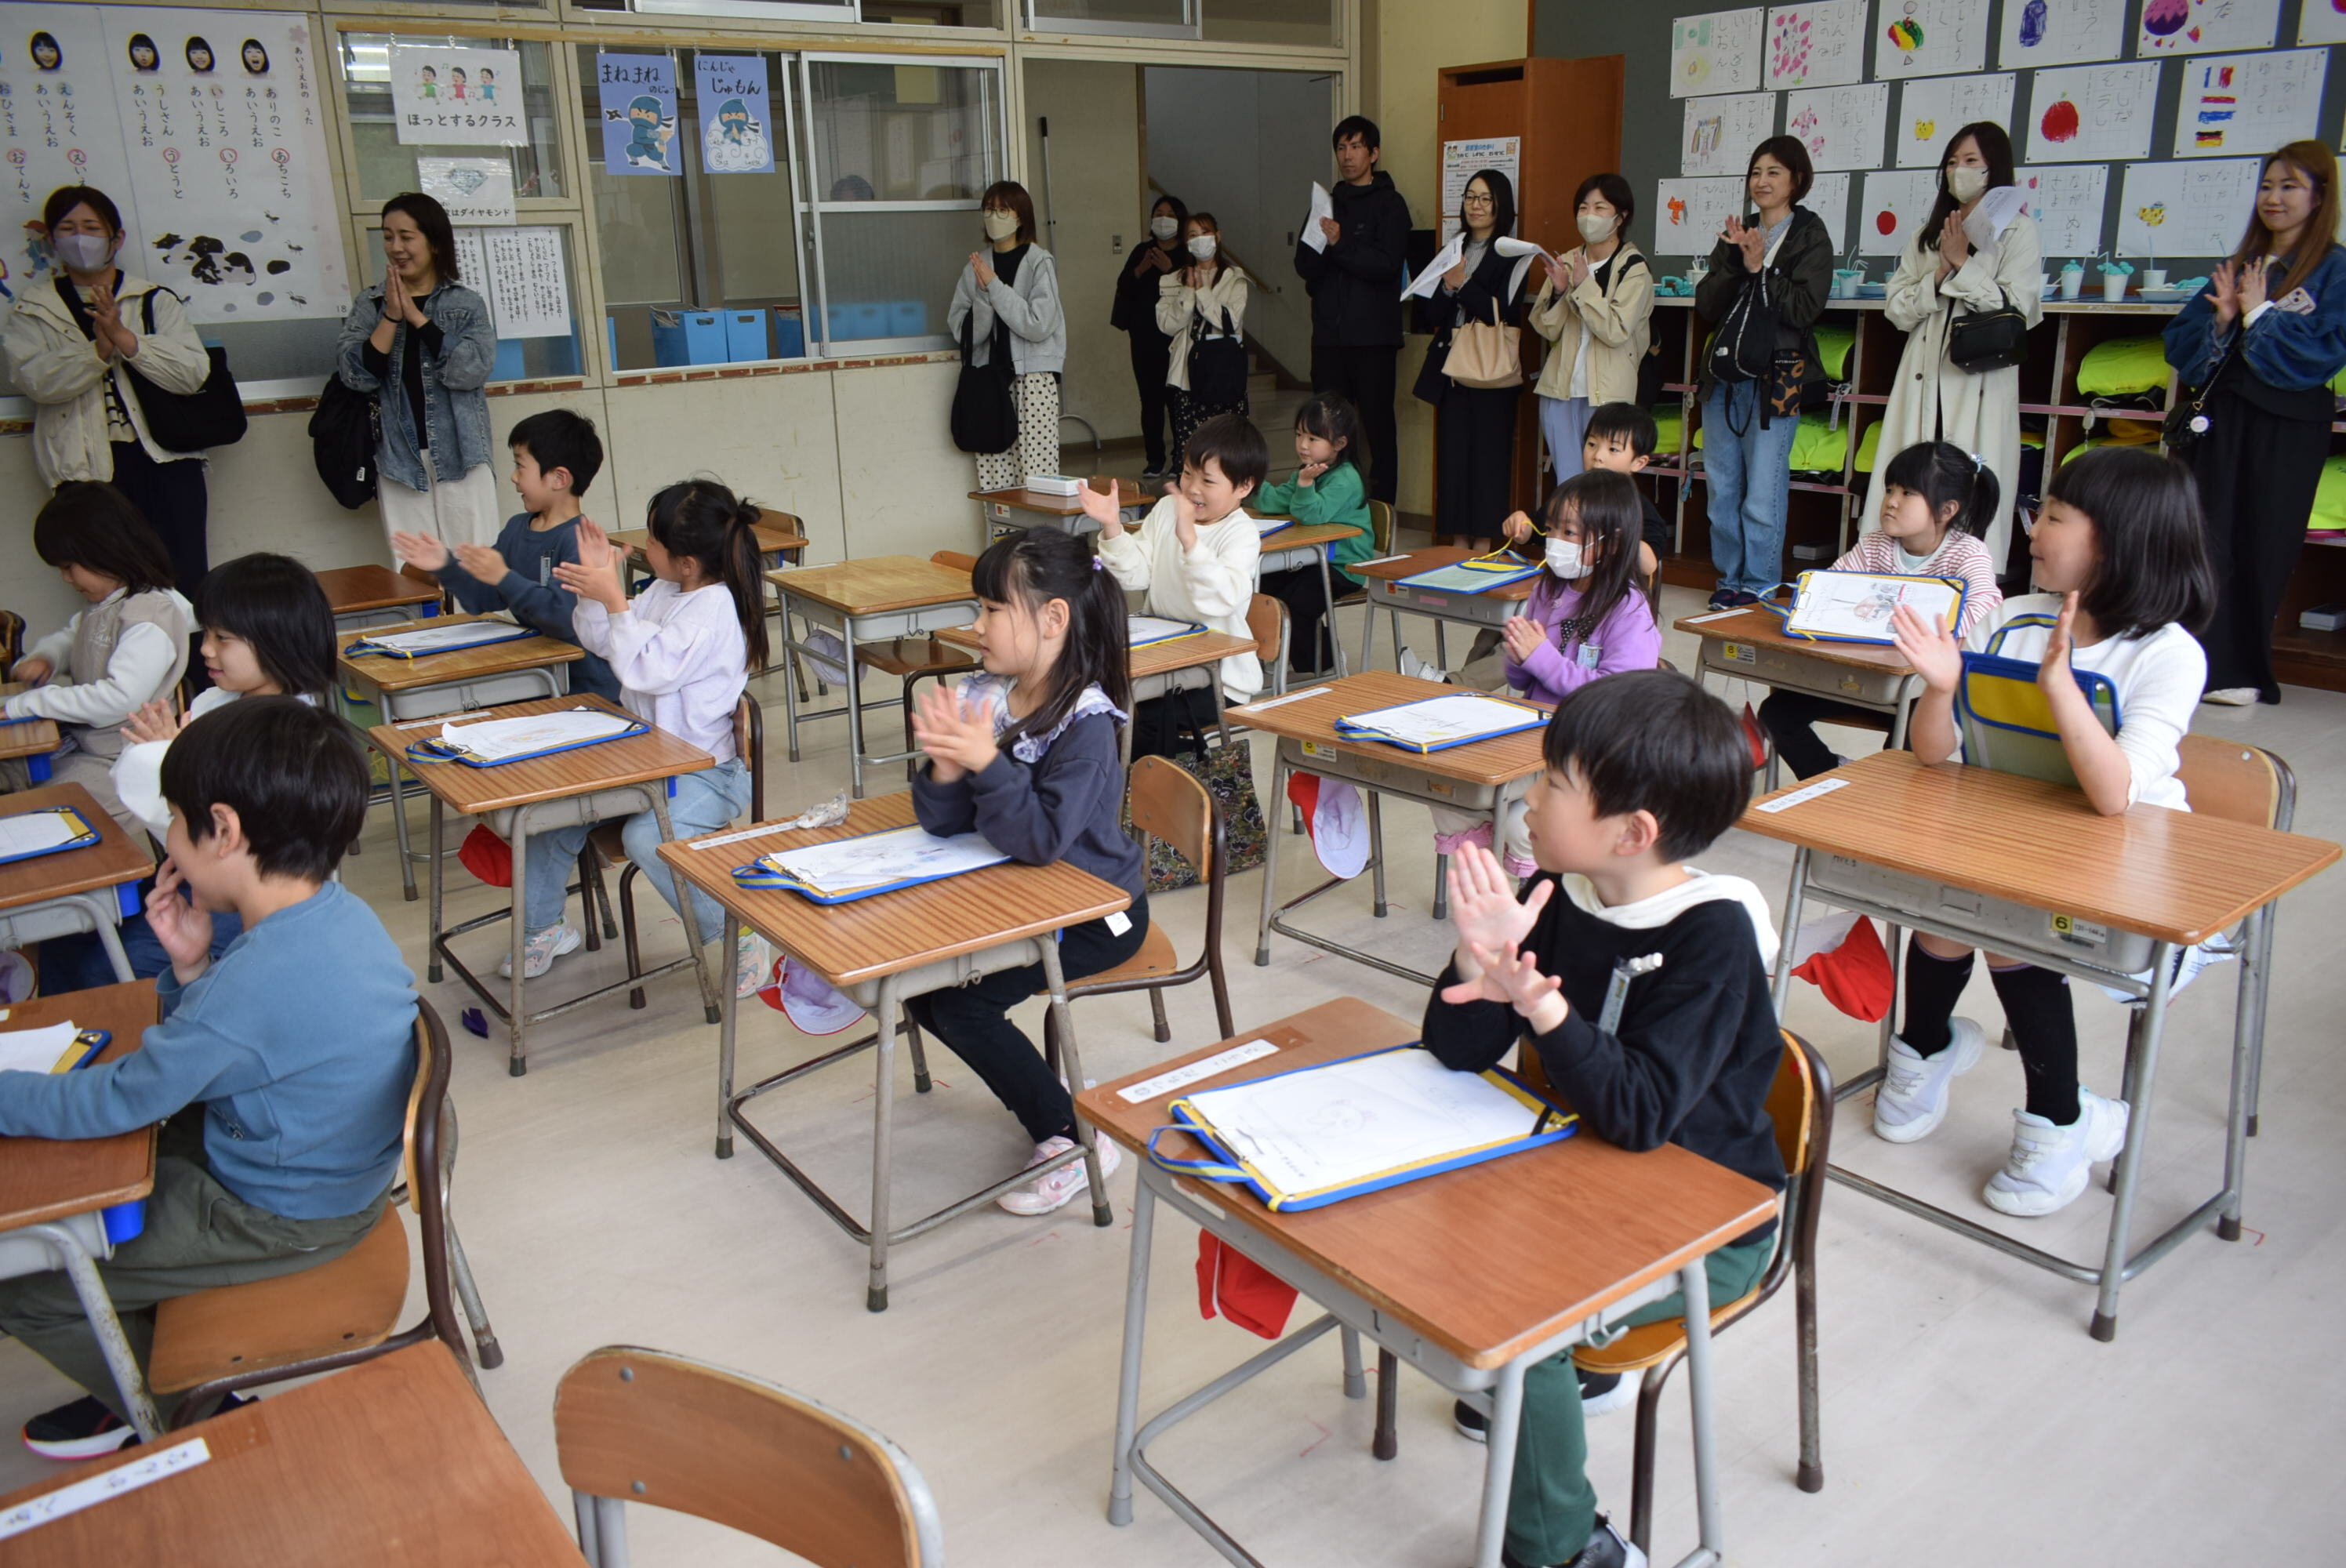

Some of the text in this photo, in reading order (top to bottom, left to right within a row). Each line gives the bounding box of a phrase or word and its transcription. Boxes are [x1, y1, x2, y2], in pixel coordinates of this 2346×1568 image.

[601, 64, 659, 84] まねまね
[698, 60, 736, 74] にんじゃ
[1730, 13, 1745, 83] いしざき
[36, 83, 59, 147] あいうえお
[60, 82, 78, 136] えんそく
[133, 84, 154, 147] あいうえお
[190, 85, 210, 147] あいうえお
[295, 46, 313, 125] あいうえおの うた
[711, 77, 761, 96] じゅもん
[156, 85, 183, 199] うしさん うとうと
[211, 87, 238, 199] いしころ いろいろ
[245, 87, 264, 147] あいうえお
[265, 87, 292, 199] ありのこ あちこち
[407, 113, 517, 129] ほっとするクラス
[336, 304, 347, 313] 18
[2055, 916, 2068, 930] 6
